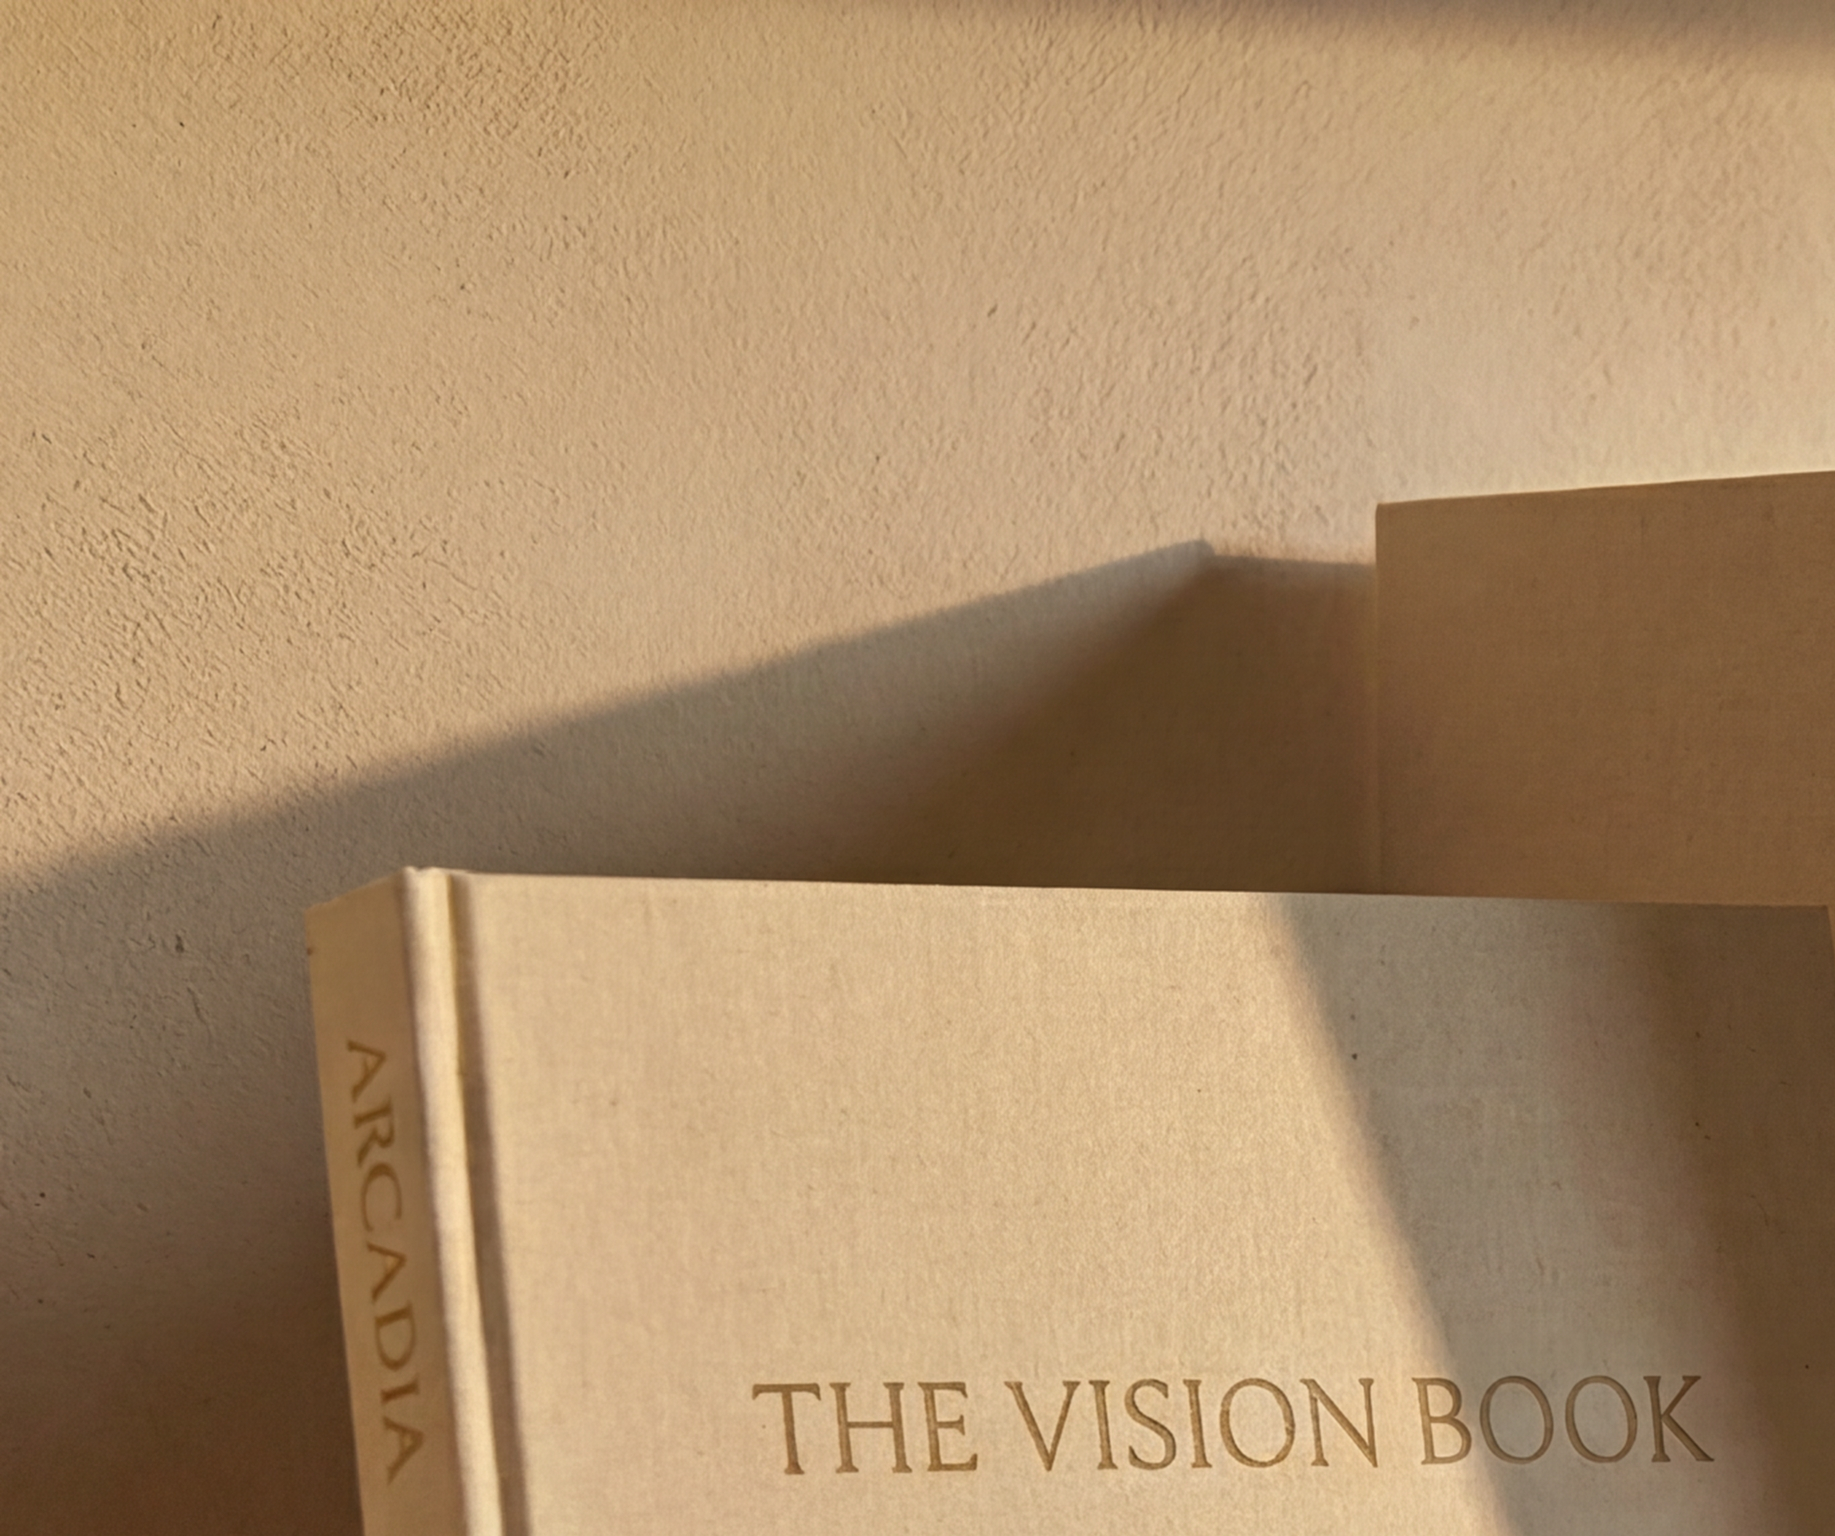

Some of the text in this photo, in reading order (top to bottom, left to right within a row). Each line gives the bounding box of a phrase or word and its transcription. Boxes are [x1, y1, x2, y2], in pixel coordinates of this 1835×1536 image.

[346, 1038, 425, 1485] ARCADIA
[752, 1374, 1715, 1475] THE VISION BOOK
